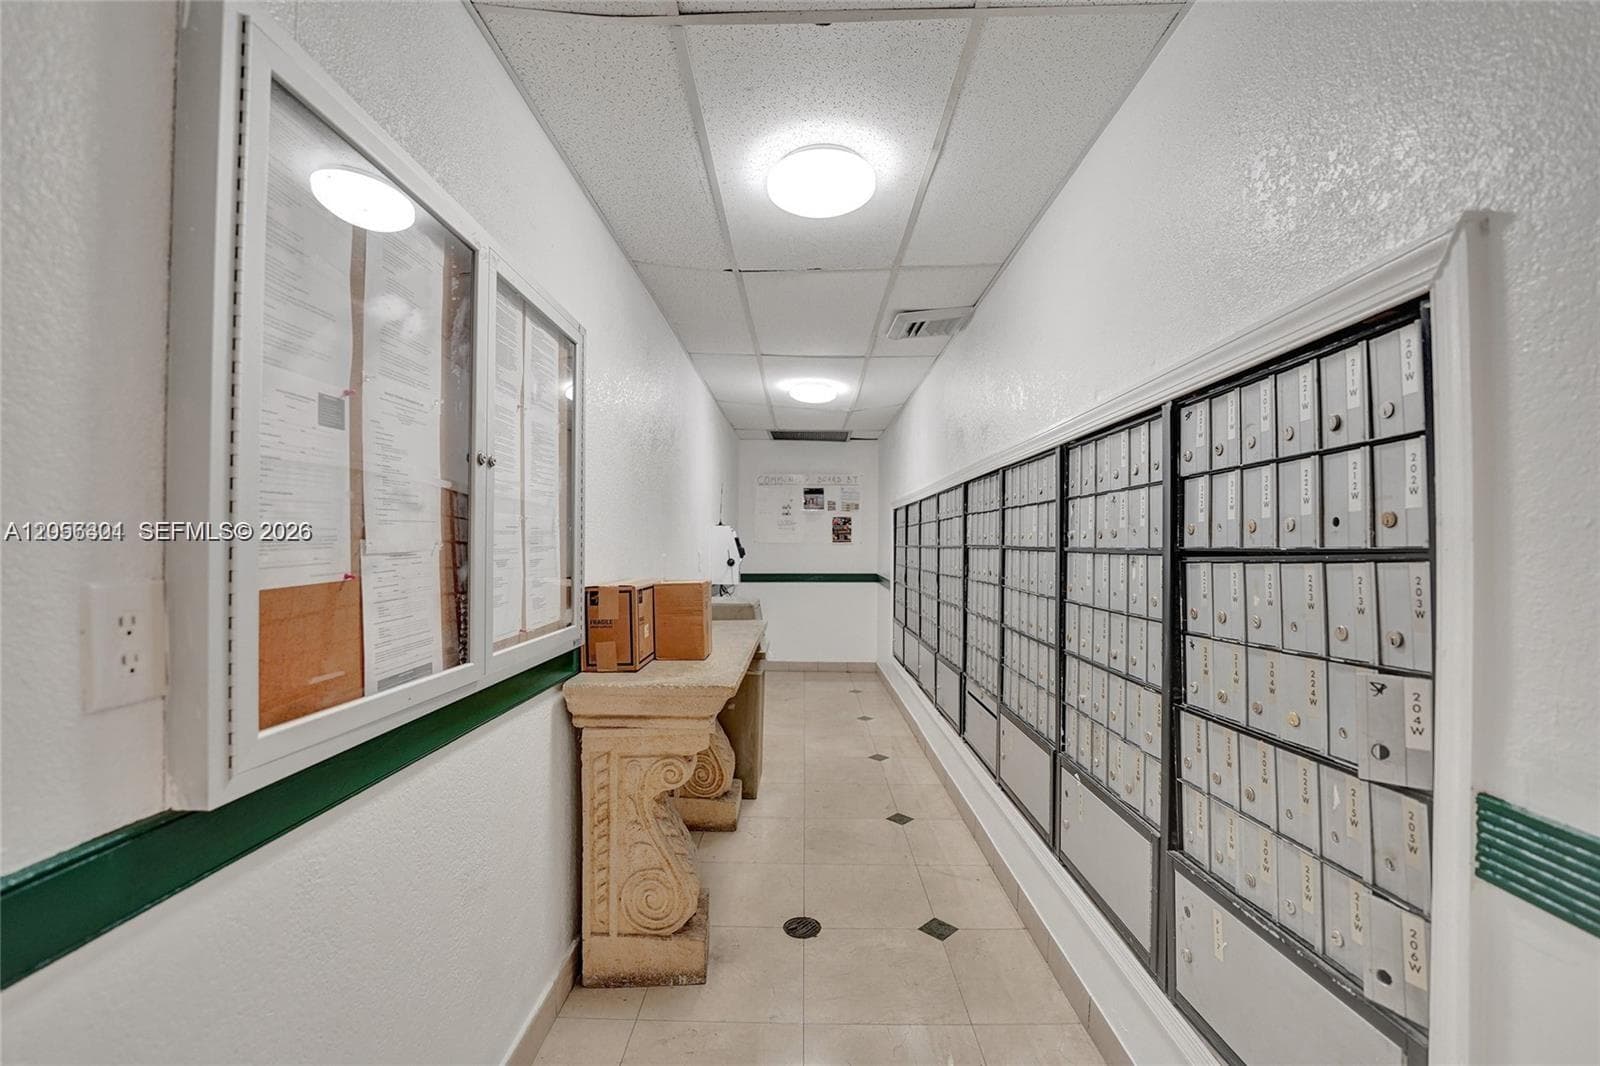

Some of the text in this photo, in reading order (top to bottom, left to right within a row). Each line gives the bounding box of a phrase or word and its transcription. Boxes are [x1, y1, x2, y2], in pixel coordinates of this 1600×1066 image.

[1348, 358, 1358, 397] 211W
[1404, 338, 1415, 381] 201W
[1350, 461, 1359, 500] 212W
[1409, 453, 1419, 495] 202W
[1356, 576, 1366, 615] 213W
[1415, 576, 1425, 619] 203W
[1308, 670, 1317, 706] 224W
[1410, 692, 1425, 736] 204W
[1349, 788, 1359, 828] 215W
[1407, 811, 1418, 855] 205W
[1354, 892, 1363, 932] 216W
[1408, 928, 1422, 974] 206W
